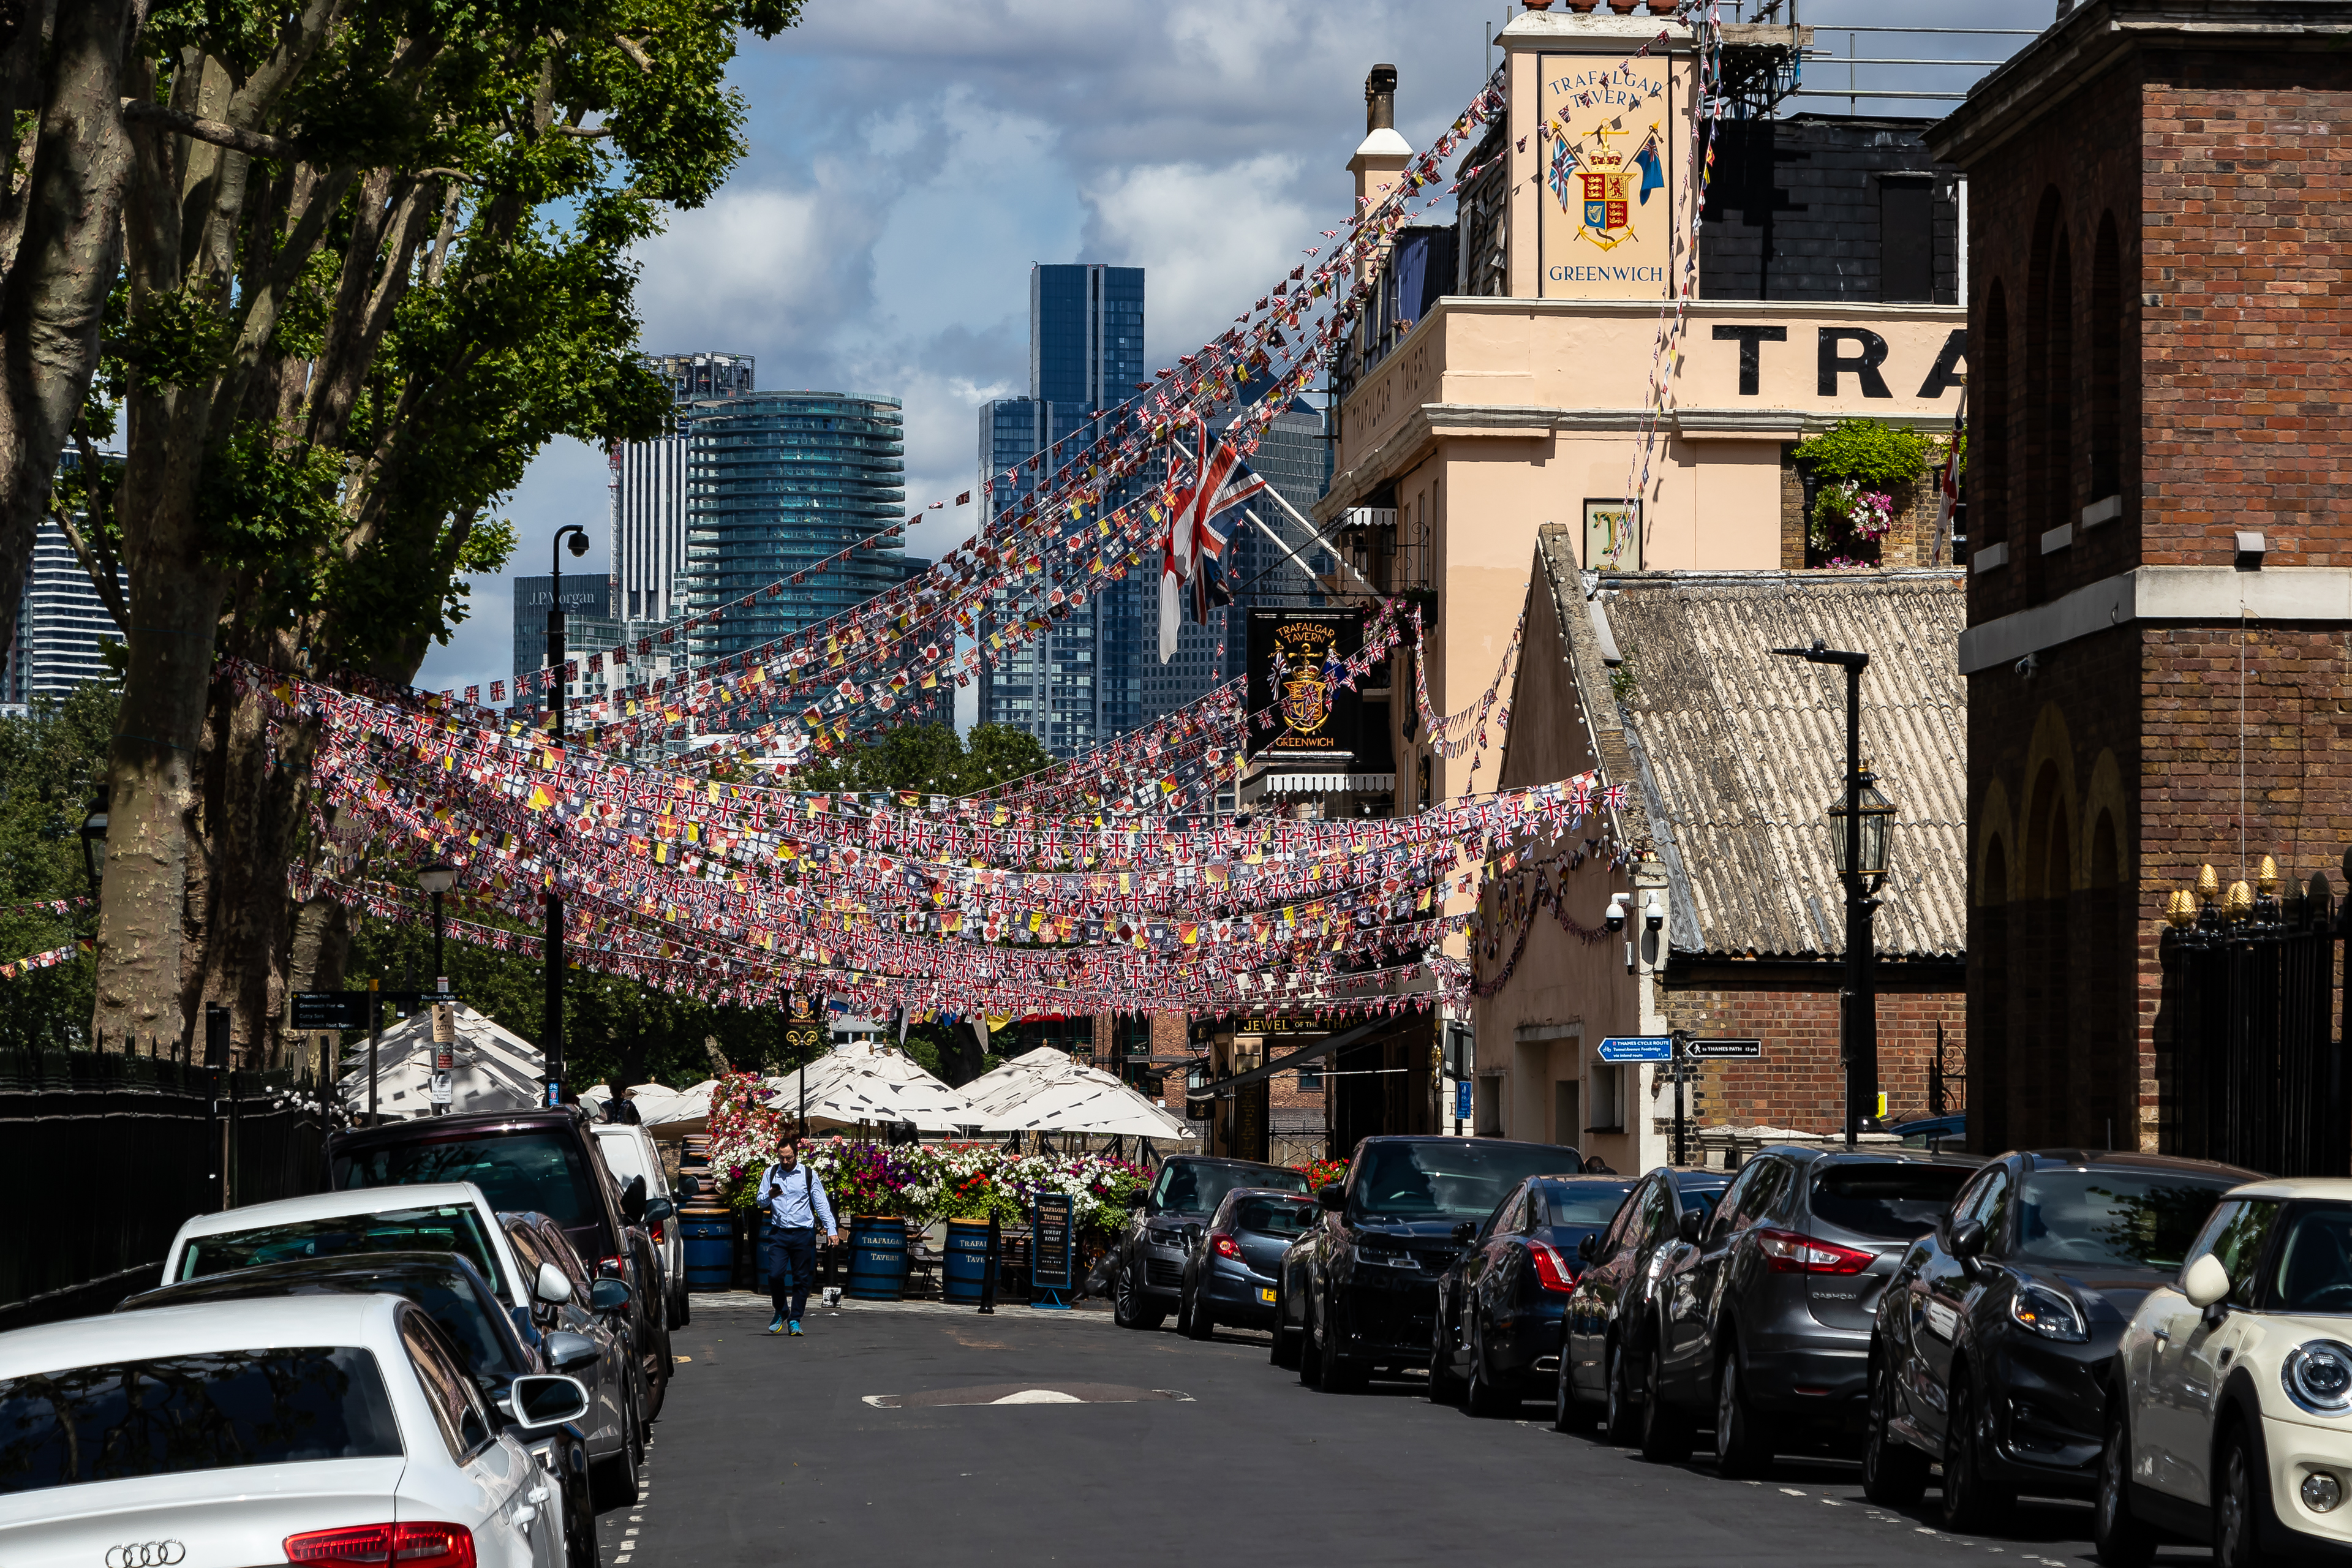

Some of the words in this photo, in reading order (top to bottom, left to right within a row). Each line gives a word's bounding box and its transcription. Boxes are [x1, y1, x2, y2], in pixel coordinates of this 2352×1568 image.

[1548, 70, 1662, 97] TRAFALGAR
[1550, 266, 1662, 281] GREENWICH
[1276, 622, 1335, 638] TRAFALGAR
[1284, 631, 1325, 644] TAVERN
[1276, 737, 1333, 747] GREENWICH
[1244, 1020, 1289, 1031] JEWEL
[1812, 1292, 1856, 1300] QASHQAI
